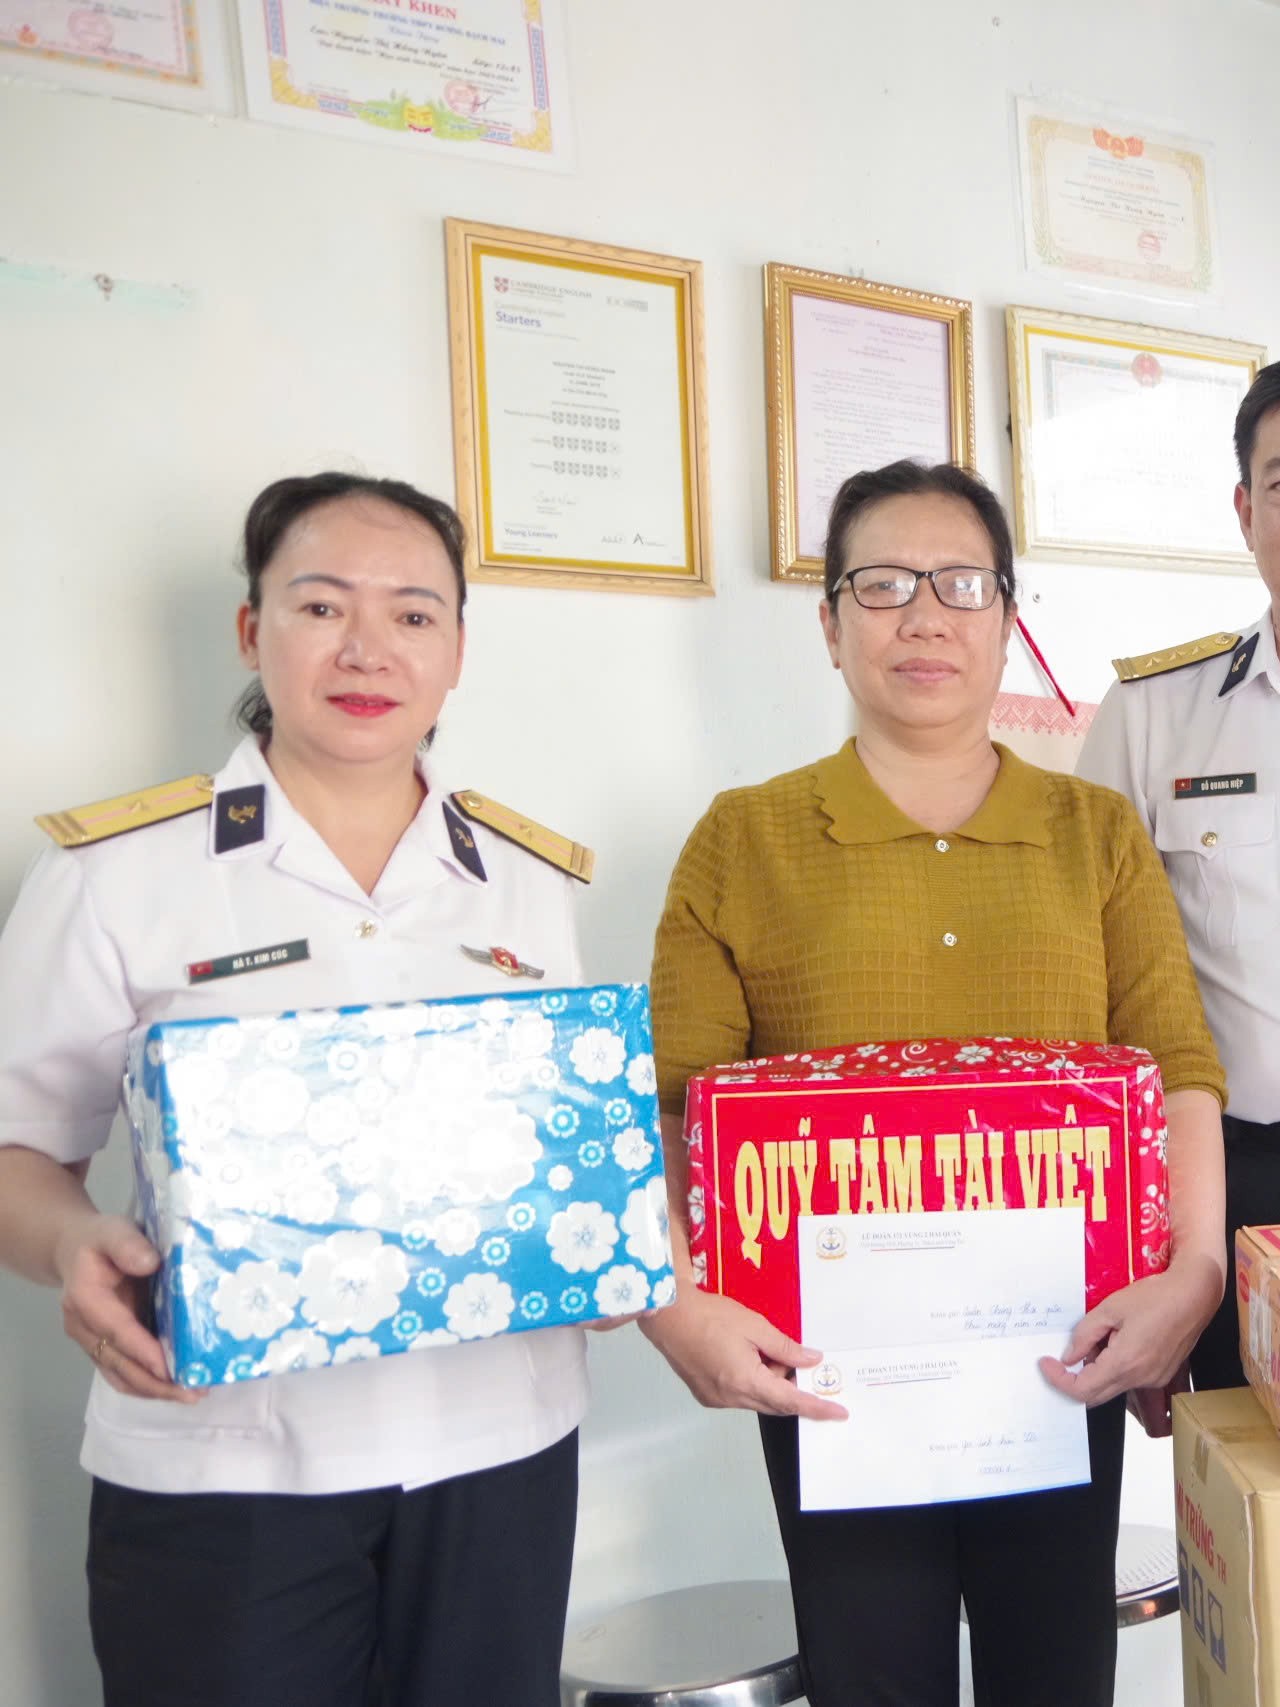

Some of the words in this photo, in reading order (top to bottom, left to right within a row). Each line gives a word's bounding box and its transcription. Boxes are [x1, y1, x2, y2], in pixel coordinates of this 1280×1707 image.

[496, 311, 542, 328] Starters
[829, 1113, 924, 1215] TÂM
[935, 1109, 1006, 1211] TÀI
